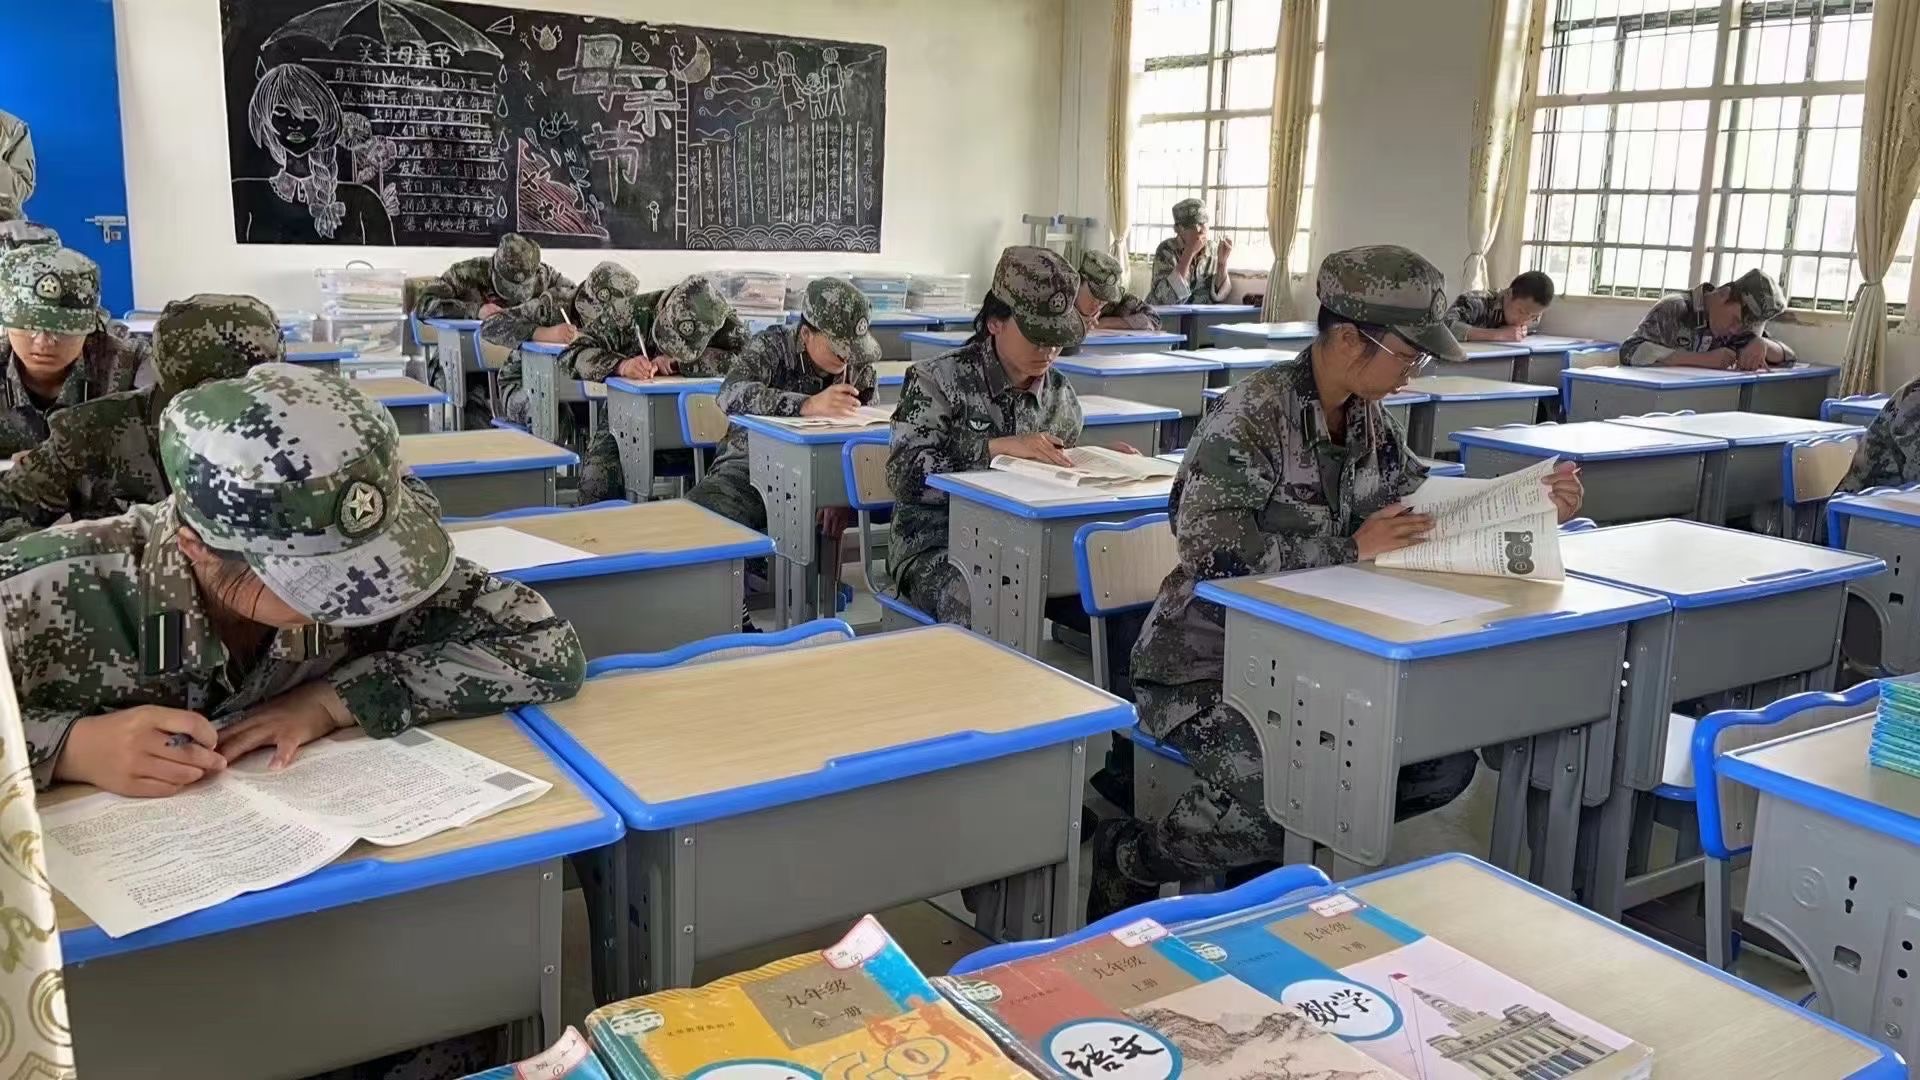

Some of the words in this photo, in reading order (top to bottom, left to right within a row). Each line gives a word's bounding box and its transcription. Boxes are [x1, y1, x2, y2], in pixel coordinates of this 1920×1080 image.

[359, 42, 451, 67] 关于母亲节
[557, 34, 681, 204] 母亲节
[1303, 921, 1351, 941] 九年级
[1341, 941, 1366, 953] 下册
[1092, 956, 1147, 979] 九年级
[783, 978, 852, 1009] 九年级
[1131, 978, 1158, 993] 上册
[811, 1005, 863, 1028] 全一册
[1295, 988, 1373, 1027] 数学
[1061, 1034, 1165, 1077] 语文
